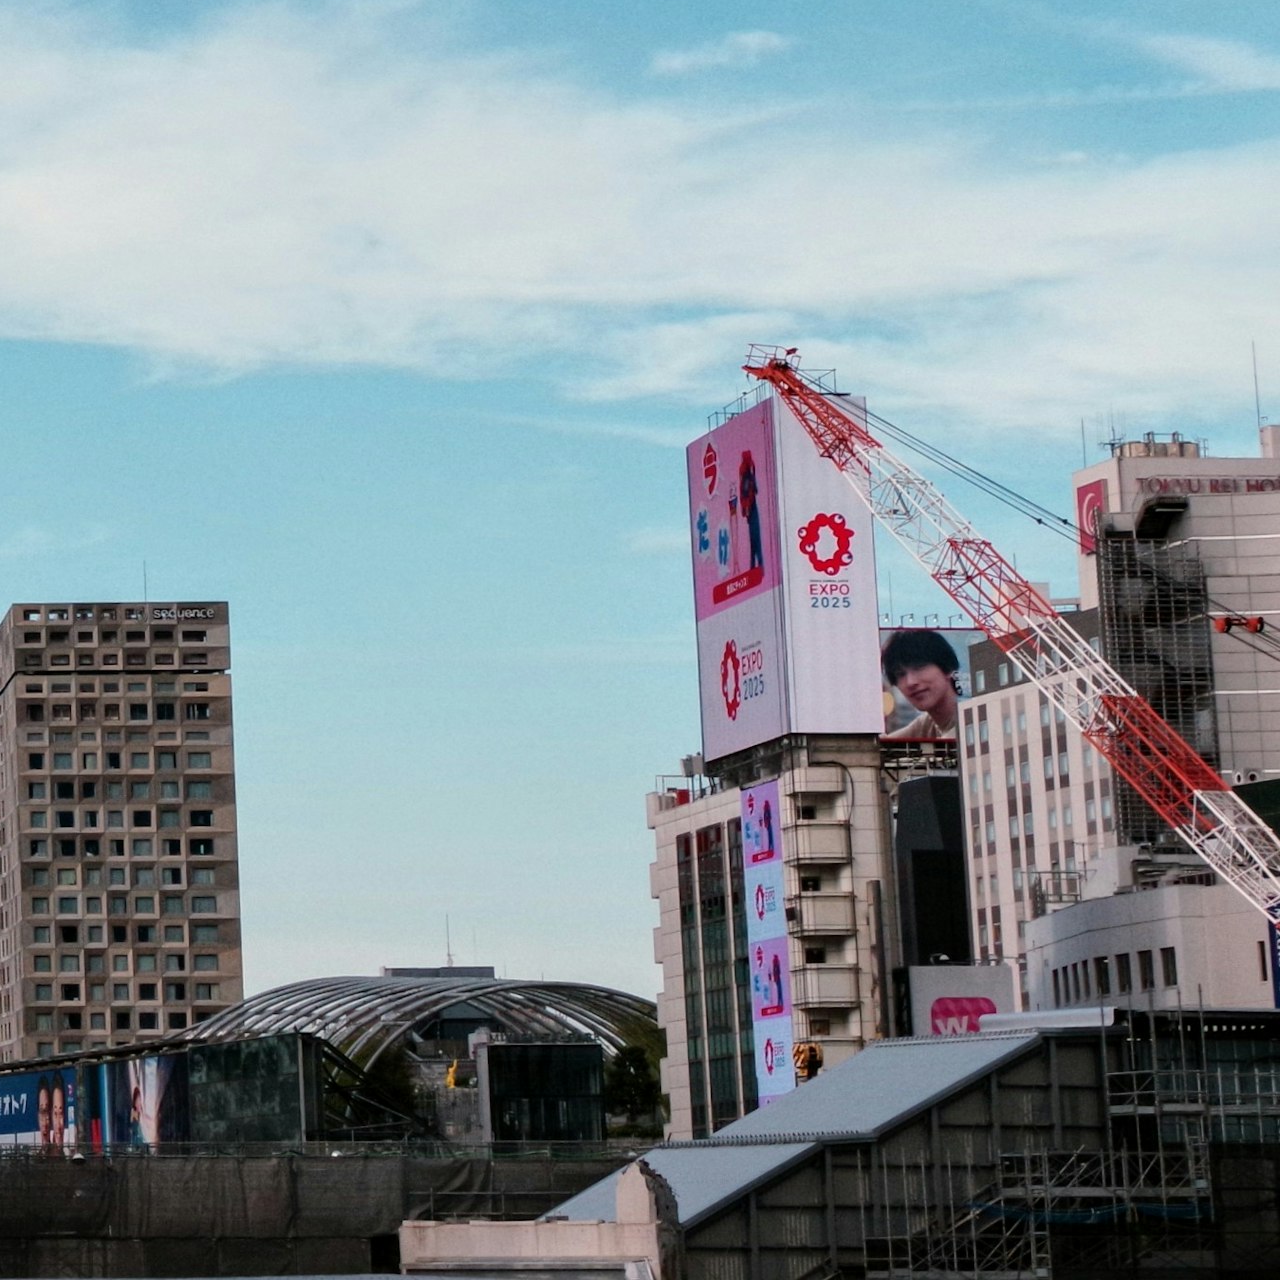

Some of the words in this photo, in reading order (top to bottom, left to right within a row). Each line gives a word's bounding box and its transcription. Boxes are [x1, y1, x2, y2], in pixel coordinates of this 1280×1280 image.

[1135, 477, 1201, 494] TOKYU
[1209, 478, 1237, 493] REI
[1246, 477, 1280, 492] HO
[808, 583, 850, 596] EXPO
[810, 596, 851, 609] 2025
[741, 648, 764, 676] EXPO
[743, 674, 766, 701] 2025
